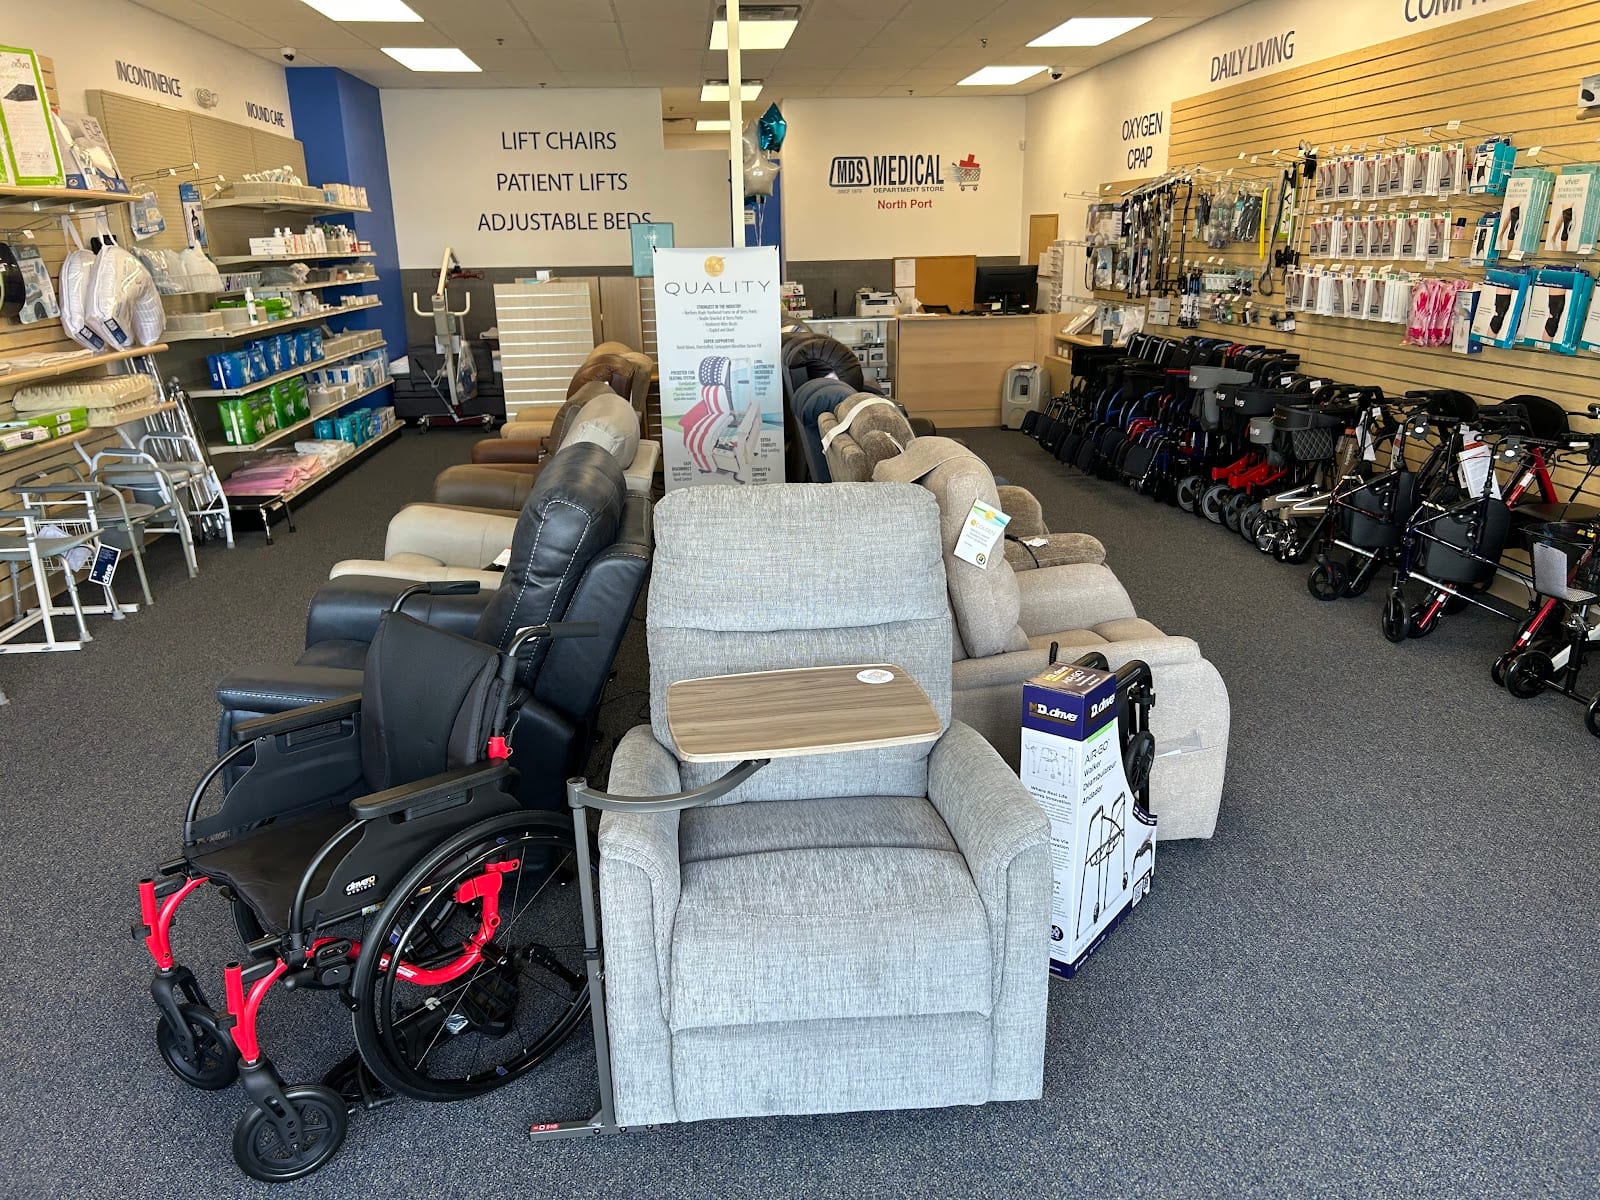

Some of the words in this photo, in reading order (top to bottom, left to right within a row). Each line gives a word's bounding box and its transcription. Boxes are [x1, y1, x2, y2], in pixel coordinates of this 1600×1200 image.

[1210, 46, 1248, 82] DAILY
[1247, 30, 1295, 72] LIVING
[115, 59, 182, 98] INCONTINENCE
[245, 101, 270, 123] WOUND
[269, 108, 285, 128] CARE
[1122, 111, 1163, 141] OXYGEN
[501, 131, 541, 150] LIFT
[545, 131, 617, 150] CHAIRS
[873, 154, 945, 186] MEDICAL
[1127, 146, 1153, 170] CPAP
[496, 173, 574, 192] PATIENT
[579, 172, 629, 191] LIFTS
[836, 159, 864, 184] MDS
[873, 186, 920, 194] DEPARTMENT
[877, 199, 907, 210] North
[910, 198, 933, 209] Port
[477, 212, 599, 231] ADJUSTABLE
[603, 212, 652, 230] BEDS
[664, 280, 771, 297] QUALITY
